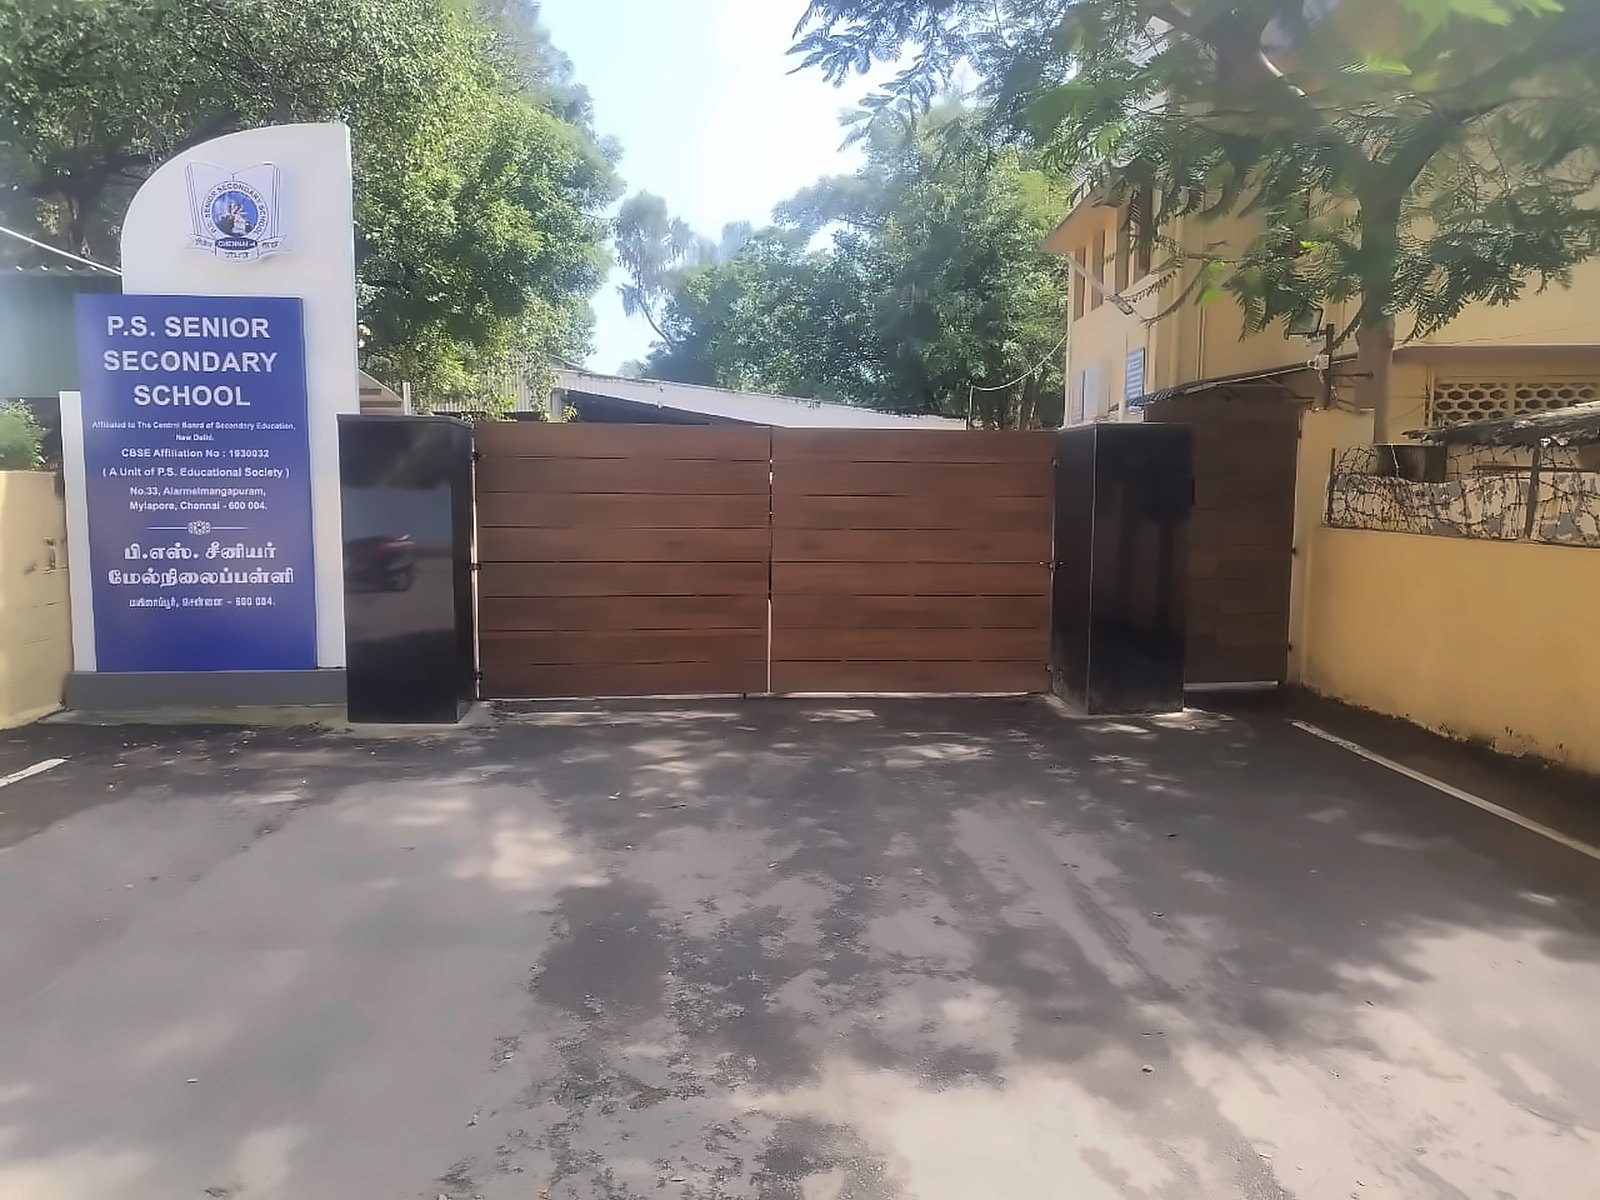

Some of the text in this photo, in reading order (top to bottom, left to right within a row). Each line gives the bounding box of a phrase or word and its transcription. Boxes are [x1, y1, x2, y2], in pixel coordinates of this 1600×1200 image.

[217, 183, 262, 204] SECONDARY
[254, 205, 267, 235] SCHOOL
[107, 315, 271, 339] P.S. SENIOR
[103, 349, 279, 373] SECONDARY
[133, 385, 251, 406] SCHOOL
[92, 420, 296, 431] Affiliated to The Central Board of Secondary Education,
[175, 433, 192, 441] New
[121, 448, 151, 459] CBSE
[153, 448, 203, 459] Affiliation
[205, 449, 220, 458] No
[229, 449, 270, 459] 1930032
[109, 467, 118, 477] A
[119, 467, 142, 477] Unit
[144, 467, 155, 477] of
[157, 467, 178, 478] P.S.
[180, 467, 242, 478] Educational
[244, 467, 284, 479] Society
[129, 486, 266, 498] No.33, Alarmelmangapuram,
[129, 501, 178, 512] Mylapore,
[180, 501, 220, 511] Chennai
[228, 501, 245, 511] 600
[247, 501, 268, 511] 004.
[124, 541, 277, 560] பி.எஸ். சீனியர்
[107, 567, 295, 588] மேல்நிலைப்பள்ளி
[182, 597, 224, 608] சென்னை
